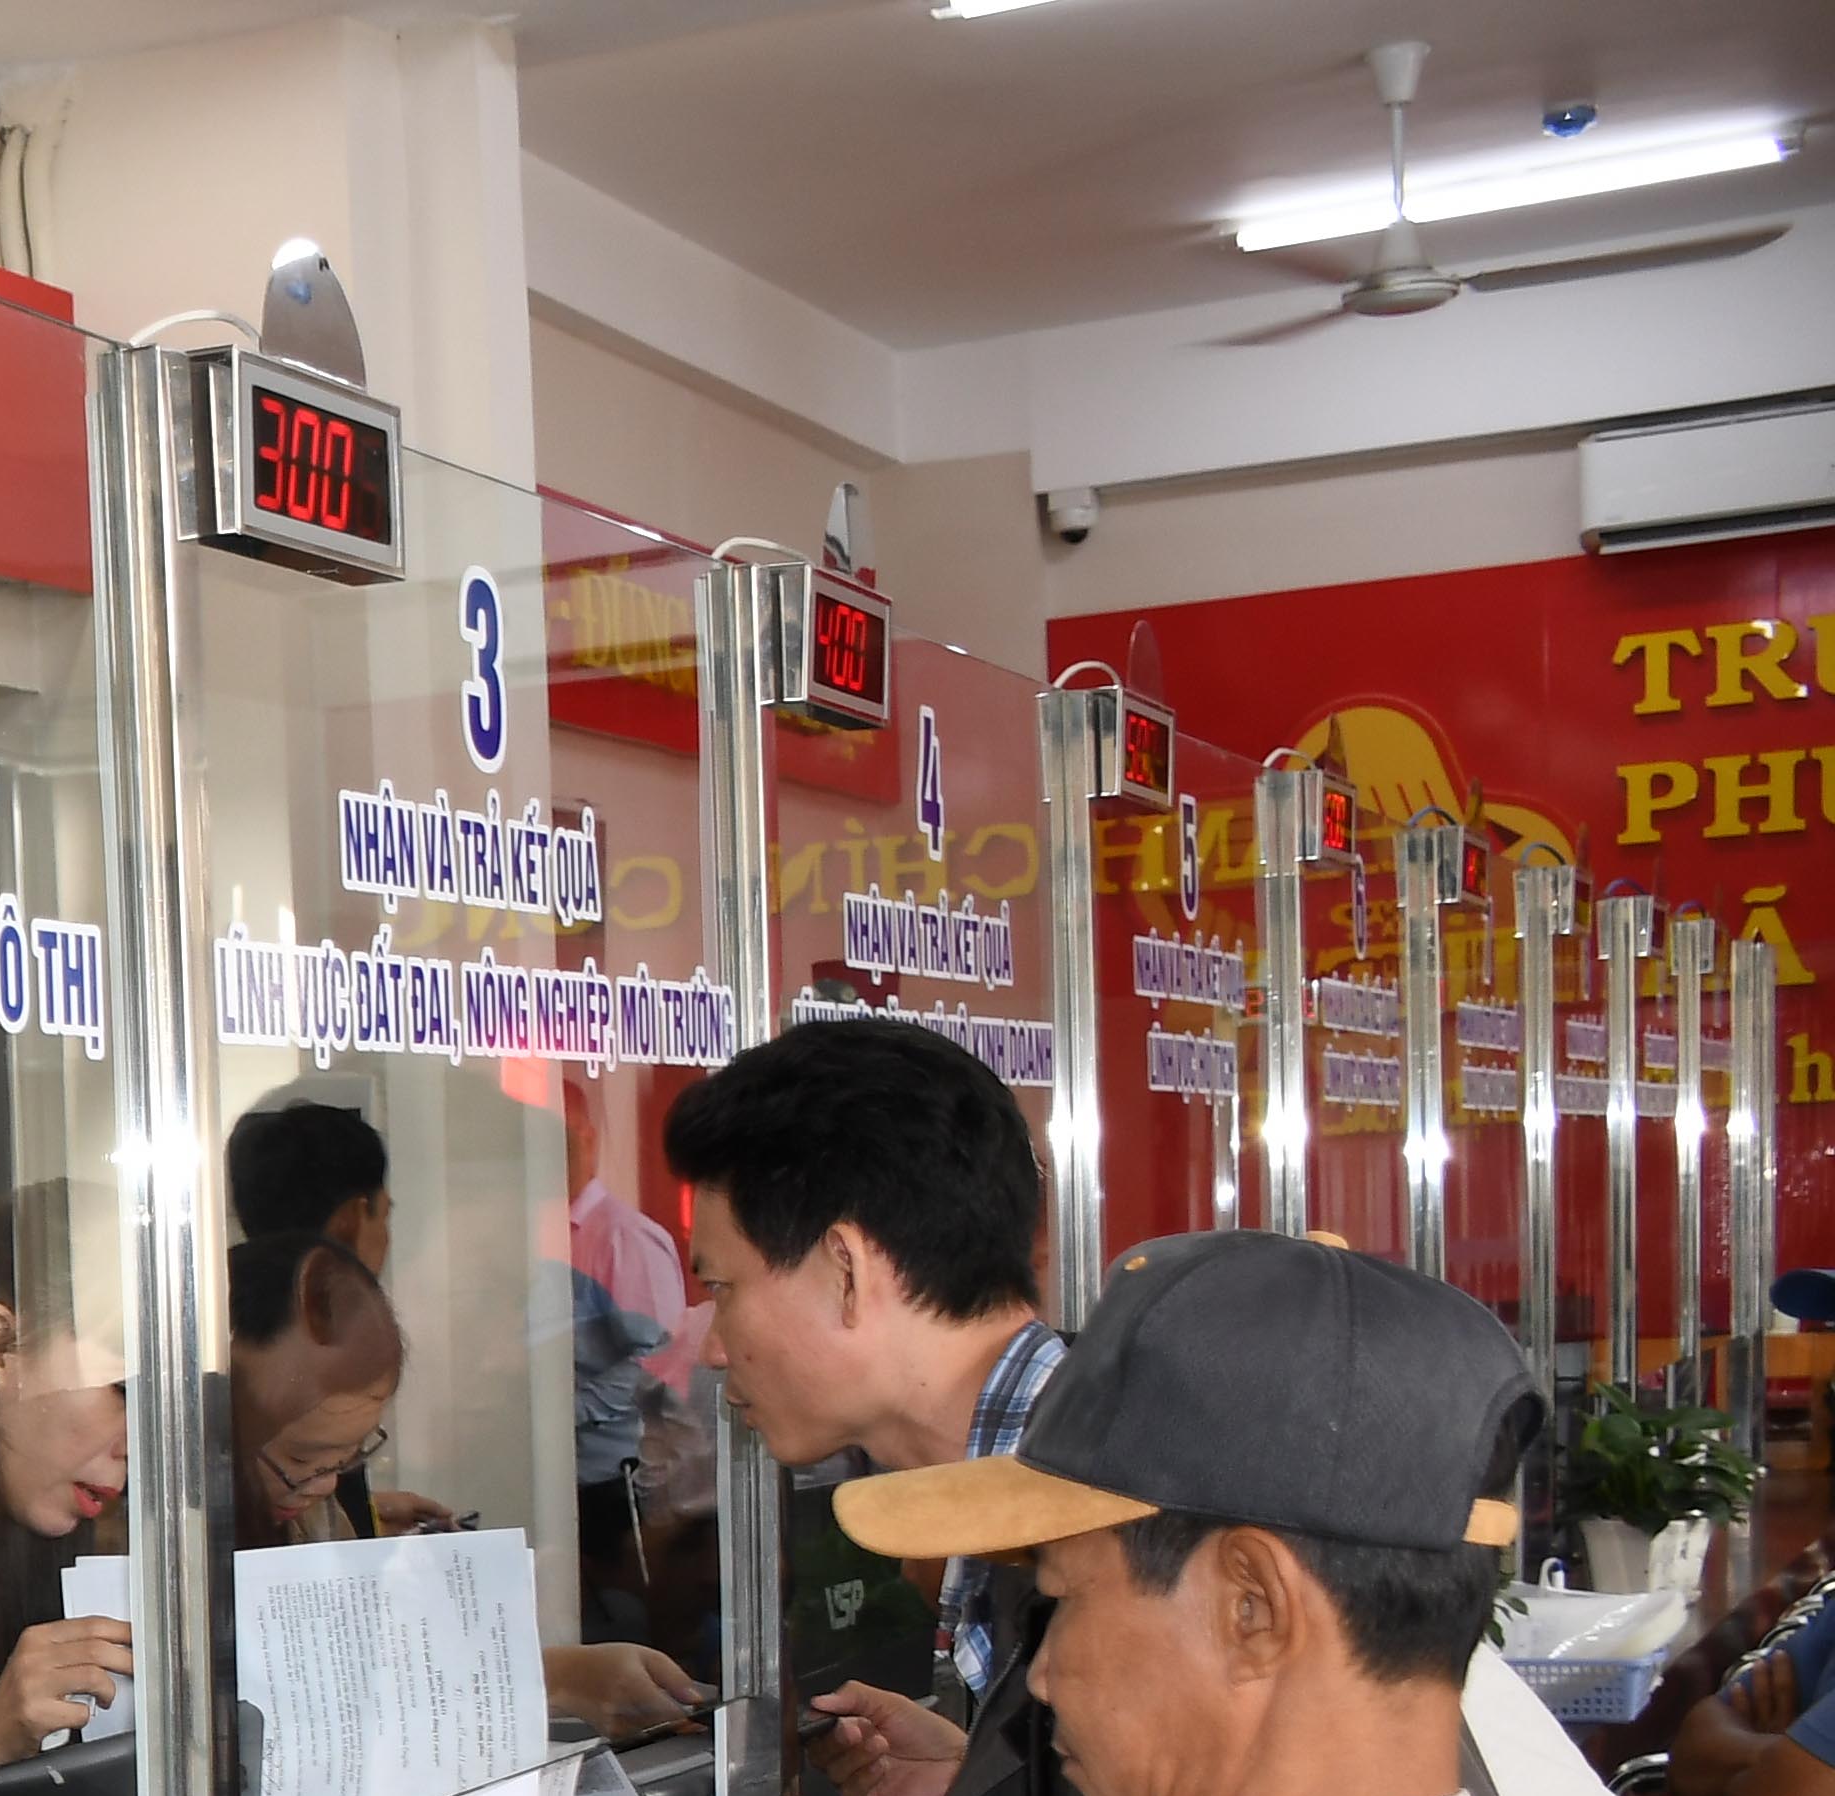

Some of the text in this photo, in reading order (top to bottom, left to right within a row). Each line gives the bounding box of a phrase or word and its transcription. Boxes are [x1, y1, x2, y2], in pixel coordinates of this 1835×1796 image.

[256, 396, 354, 533] 300
[464, 577, 503, 761] 3
[818, 602, 868, 691] 400
[1613, 616, 1835, 716] TR
[919, 716, 943, 852] 4
[1616, 745, 1835, 846] PH
[342, 789, 600, 918] NHẬN VÀ TRẢ KẾT QUẢ
[1181, 802, 1197, 913] 5
[38, 930, 99, 1043] THỊ
[846, 888, 1011, 986] NHẬN VÀ TRẢ KẾT QUẢ
[221, 929, 285, 1036] LĨNH
[295, 947, 349, 1062] VỰC
[357, 931, 403, 1045] ĐẤT
[411, 963, 459, 1060] ĐAI,
[466, 957, 529, 1049] NÔNG
[621, 971, 658, 1059] MÔI
[663, 975, 733, 1063] TRƯỜNG
